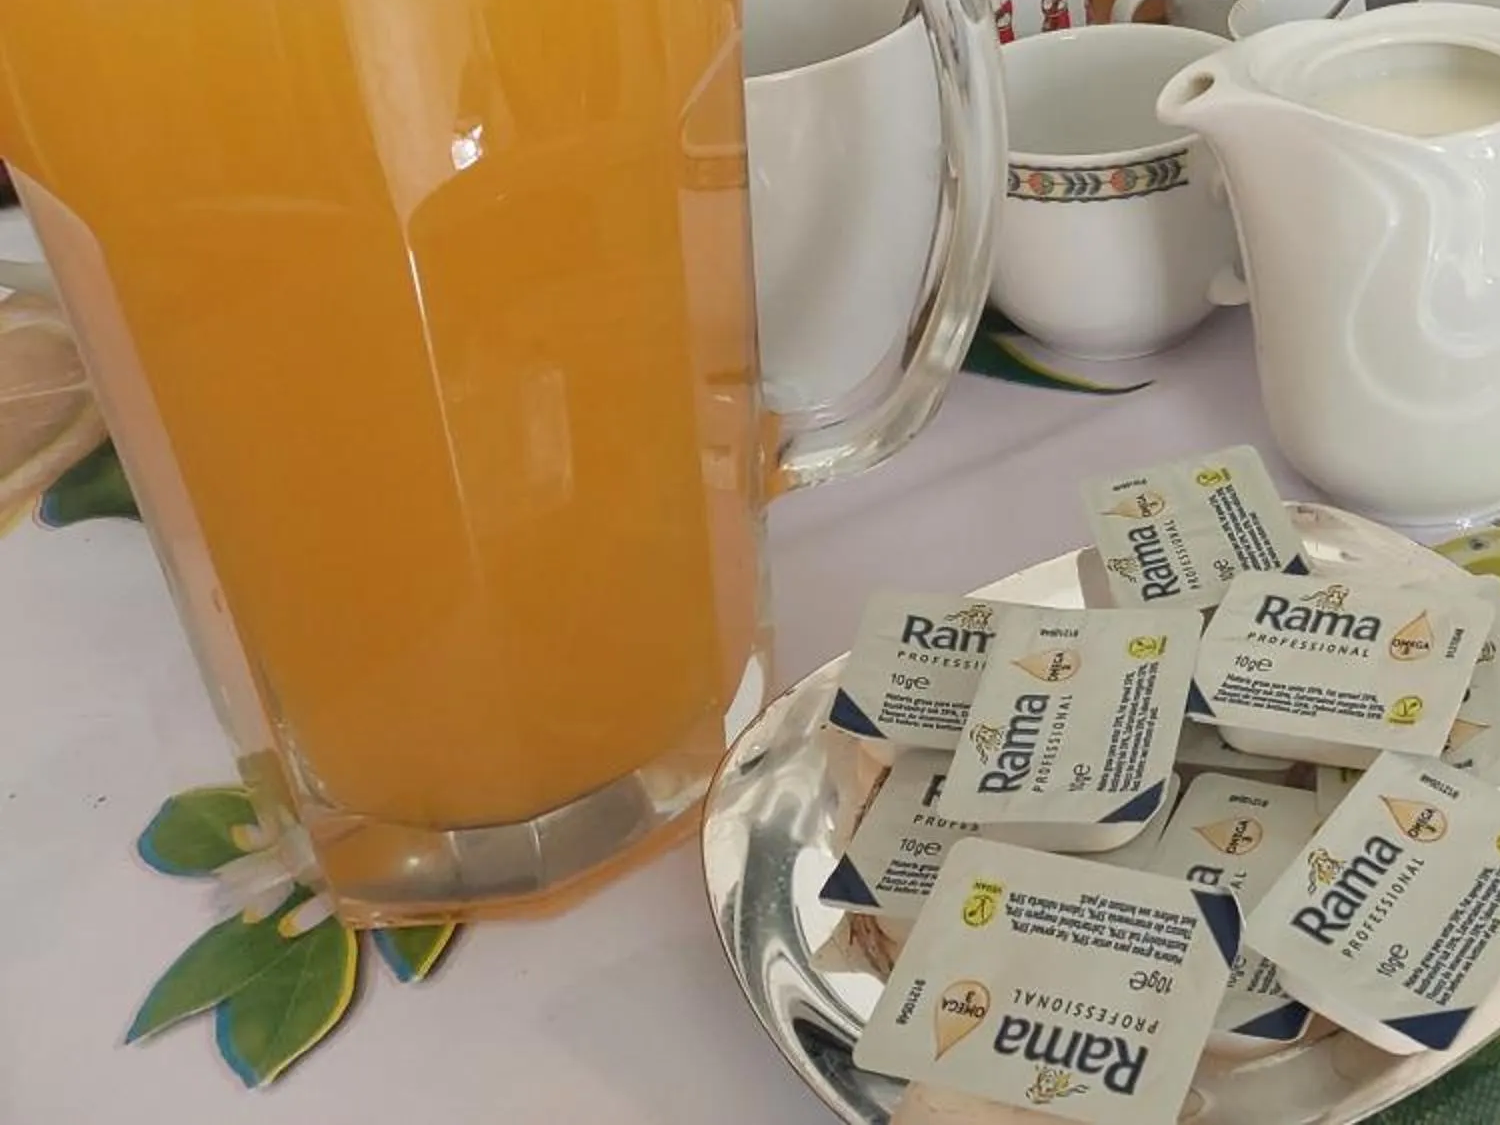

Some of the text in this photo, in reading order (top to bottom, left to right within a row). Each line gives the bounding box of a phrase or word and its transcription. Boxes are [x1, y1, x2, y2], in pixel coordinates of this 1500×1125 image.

[1128, 524, 1181, 601] Rama
[901, 614, 997, 654] Ram
[1254, 594, 1382, 643] Rama
[1247, 631, 1371, 659] PROFESSIONAL
[1391, 637, 1430, 651] OMEGA
[977, 694, 1050, 793] Rama
[1032, 694, 1073, 793] PROFESSIONAL
[1407, 807, 1435, 839] OMEGA
[1290, 835, 1403, 945] Rama
[1342, 858, 1425, 959] PROFESSIONAL
[941, 996, 987, 1019] OMEGA
[1013, 987, 1160, 1035] PROFESSIONAL
[993, 1014, 1149, 1095] Rama
